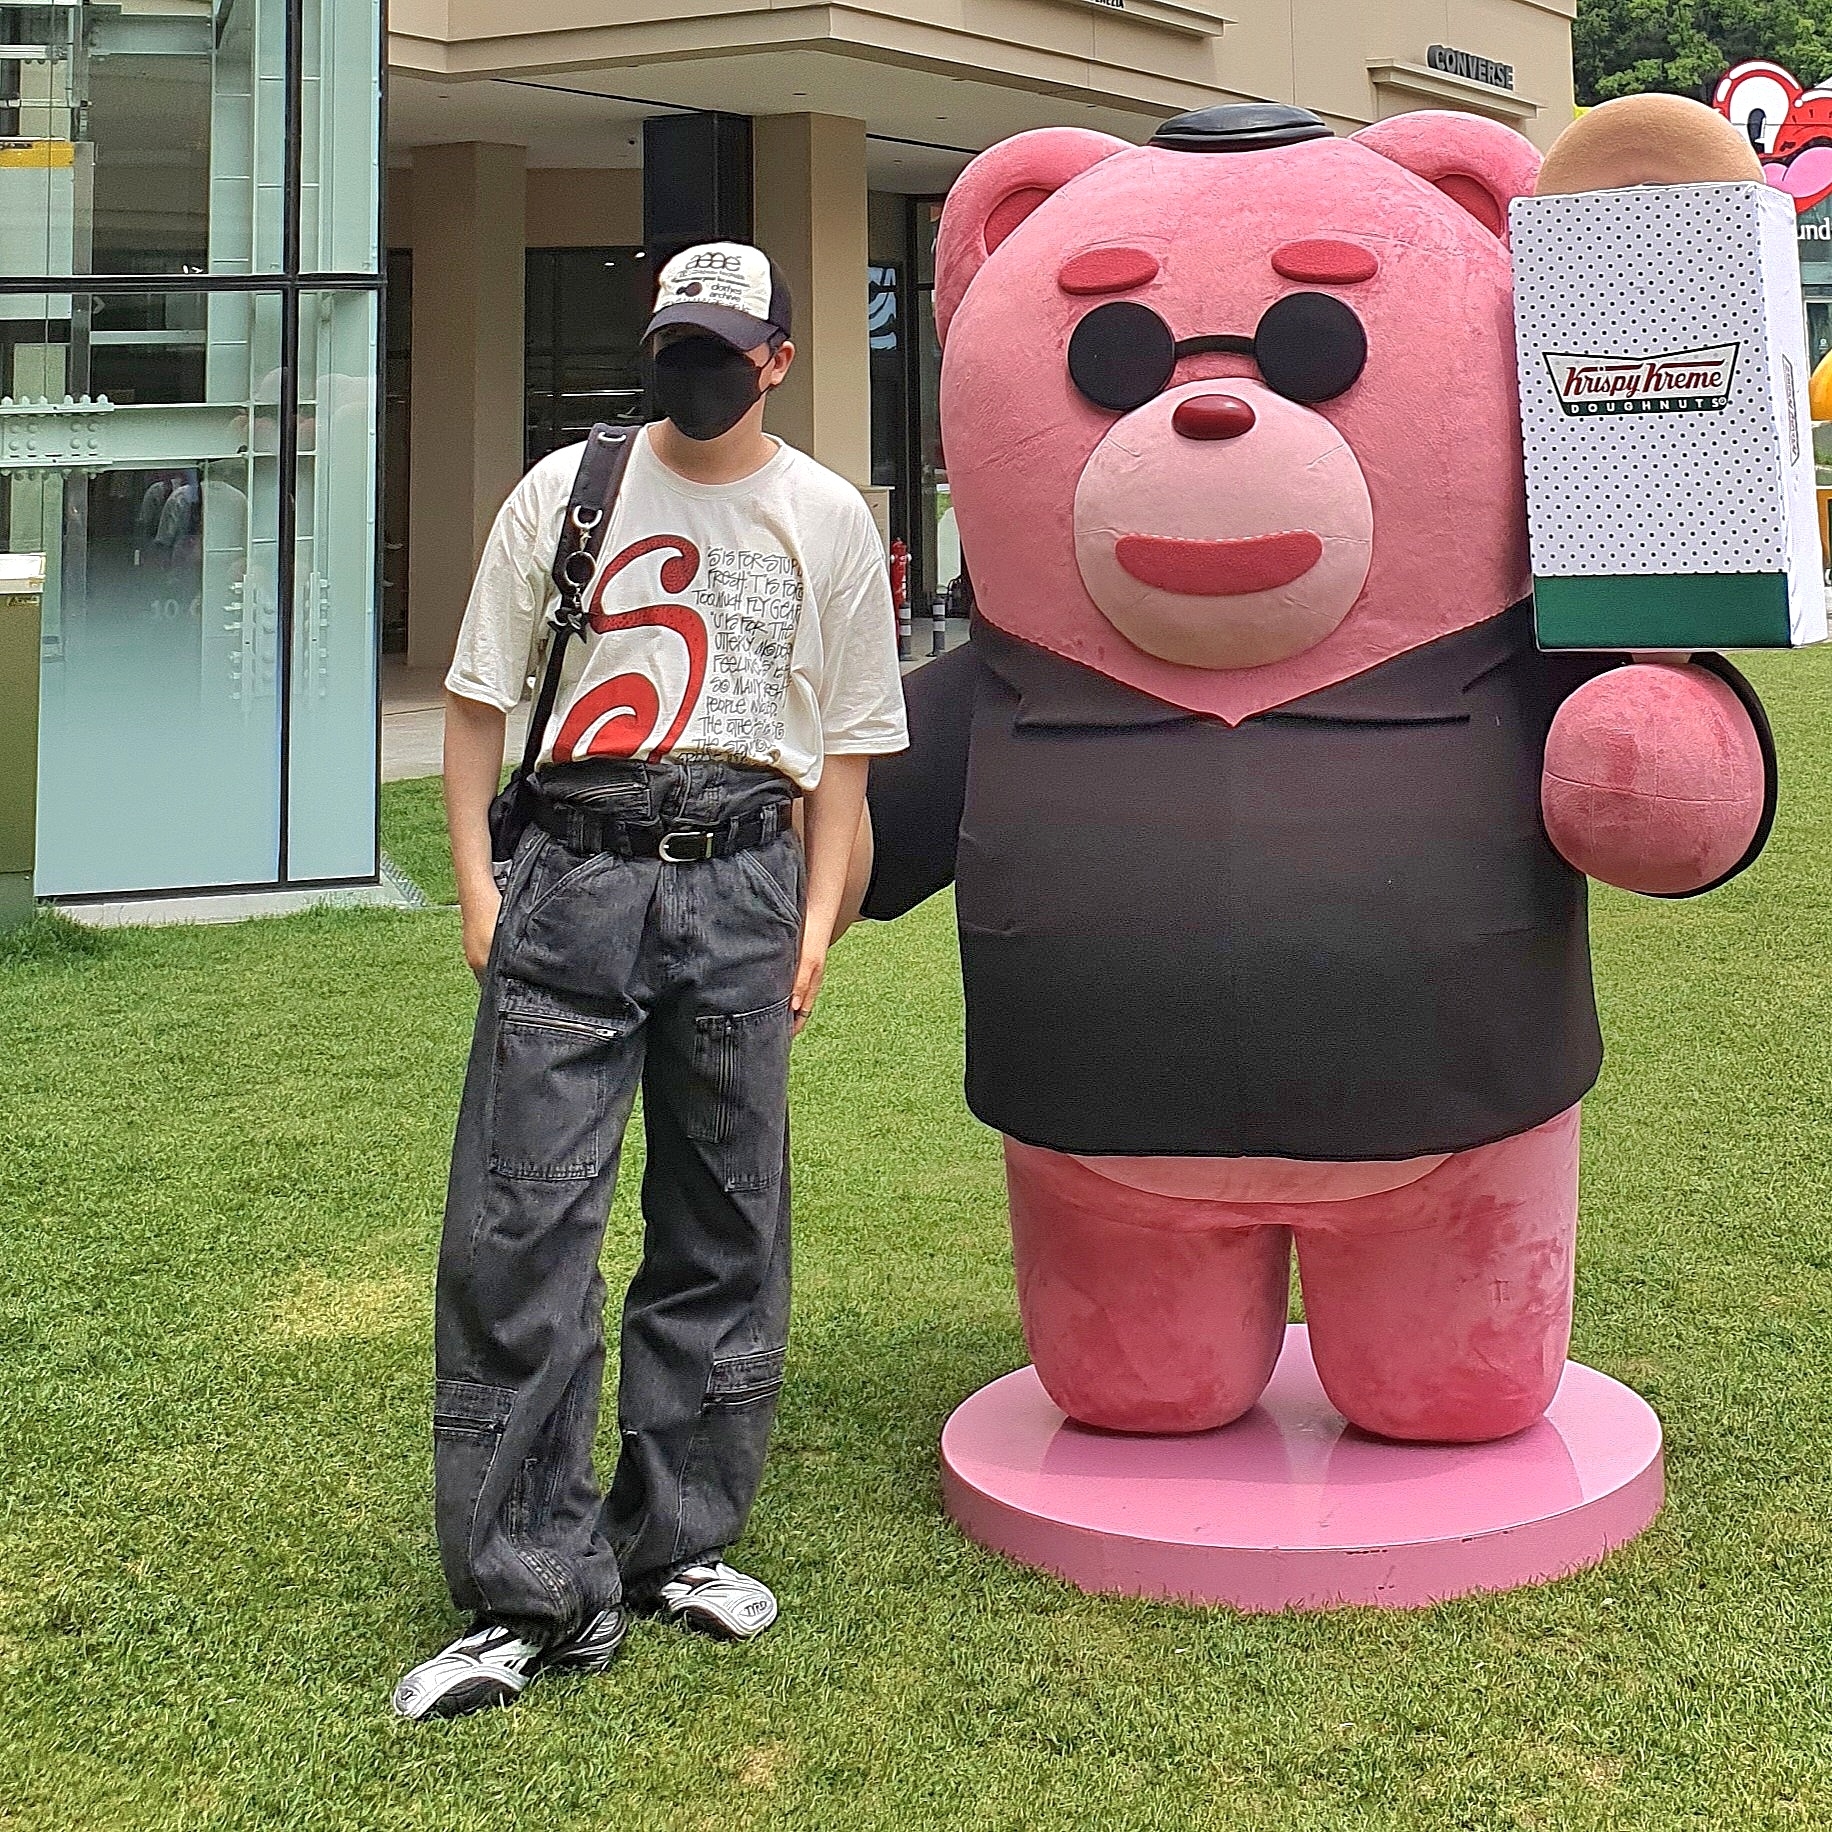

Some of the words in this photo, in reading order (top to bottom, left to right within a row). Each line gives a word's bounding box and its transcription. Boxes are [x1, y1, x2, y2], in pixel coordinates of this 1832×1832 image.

[1428, 45, 1514, 91] CONVERSE
[1563, 364, 1644, 398] Krispy
[1642, 359, 1725, 392] Kreme
[1571, 399, 1720, 414] DOUGHNUTS
